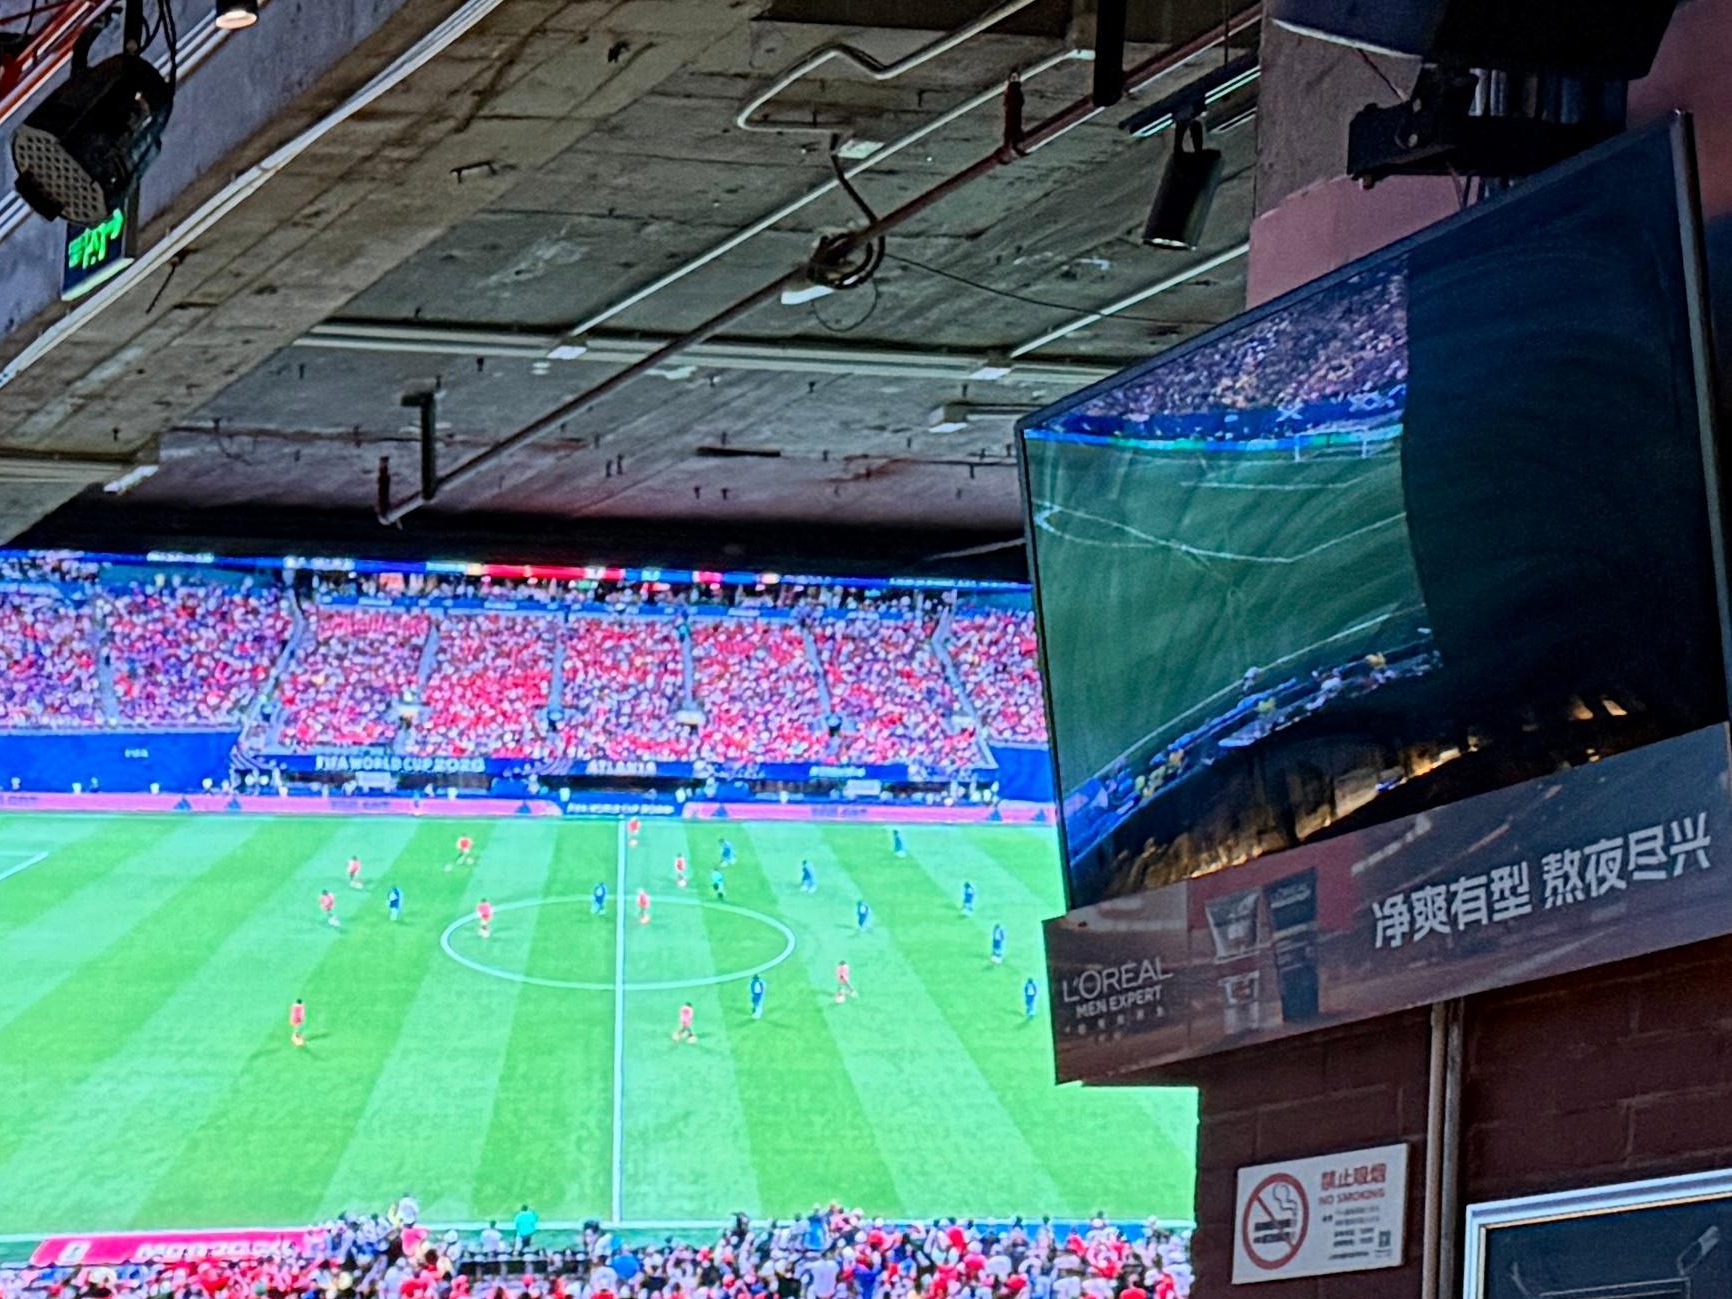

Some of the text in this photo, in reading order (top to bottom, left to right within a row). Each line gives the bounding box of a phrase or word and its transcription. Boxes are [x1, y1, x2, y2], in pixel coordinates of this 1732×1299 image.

[1371, 812, 1713, 948] 净爽有型 熬夜尽兴
[1076, 984, 1162, 1019] MEN EXPERT
